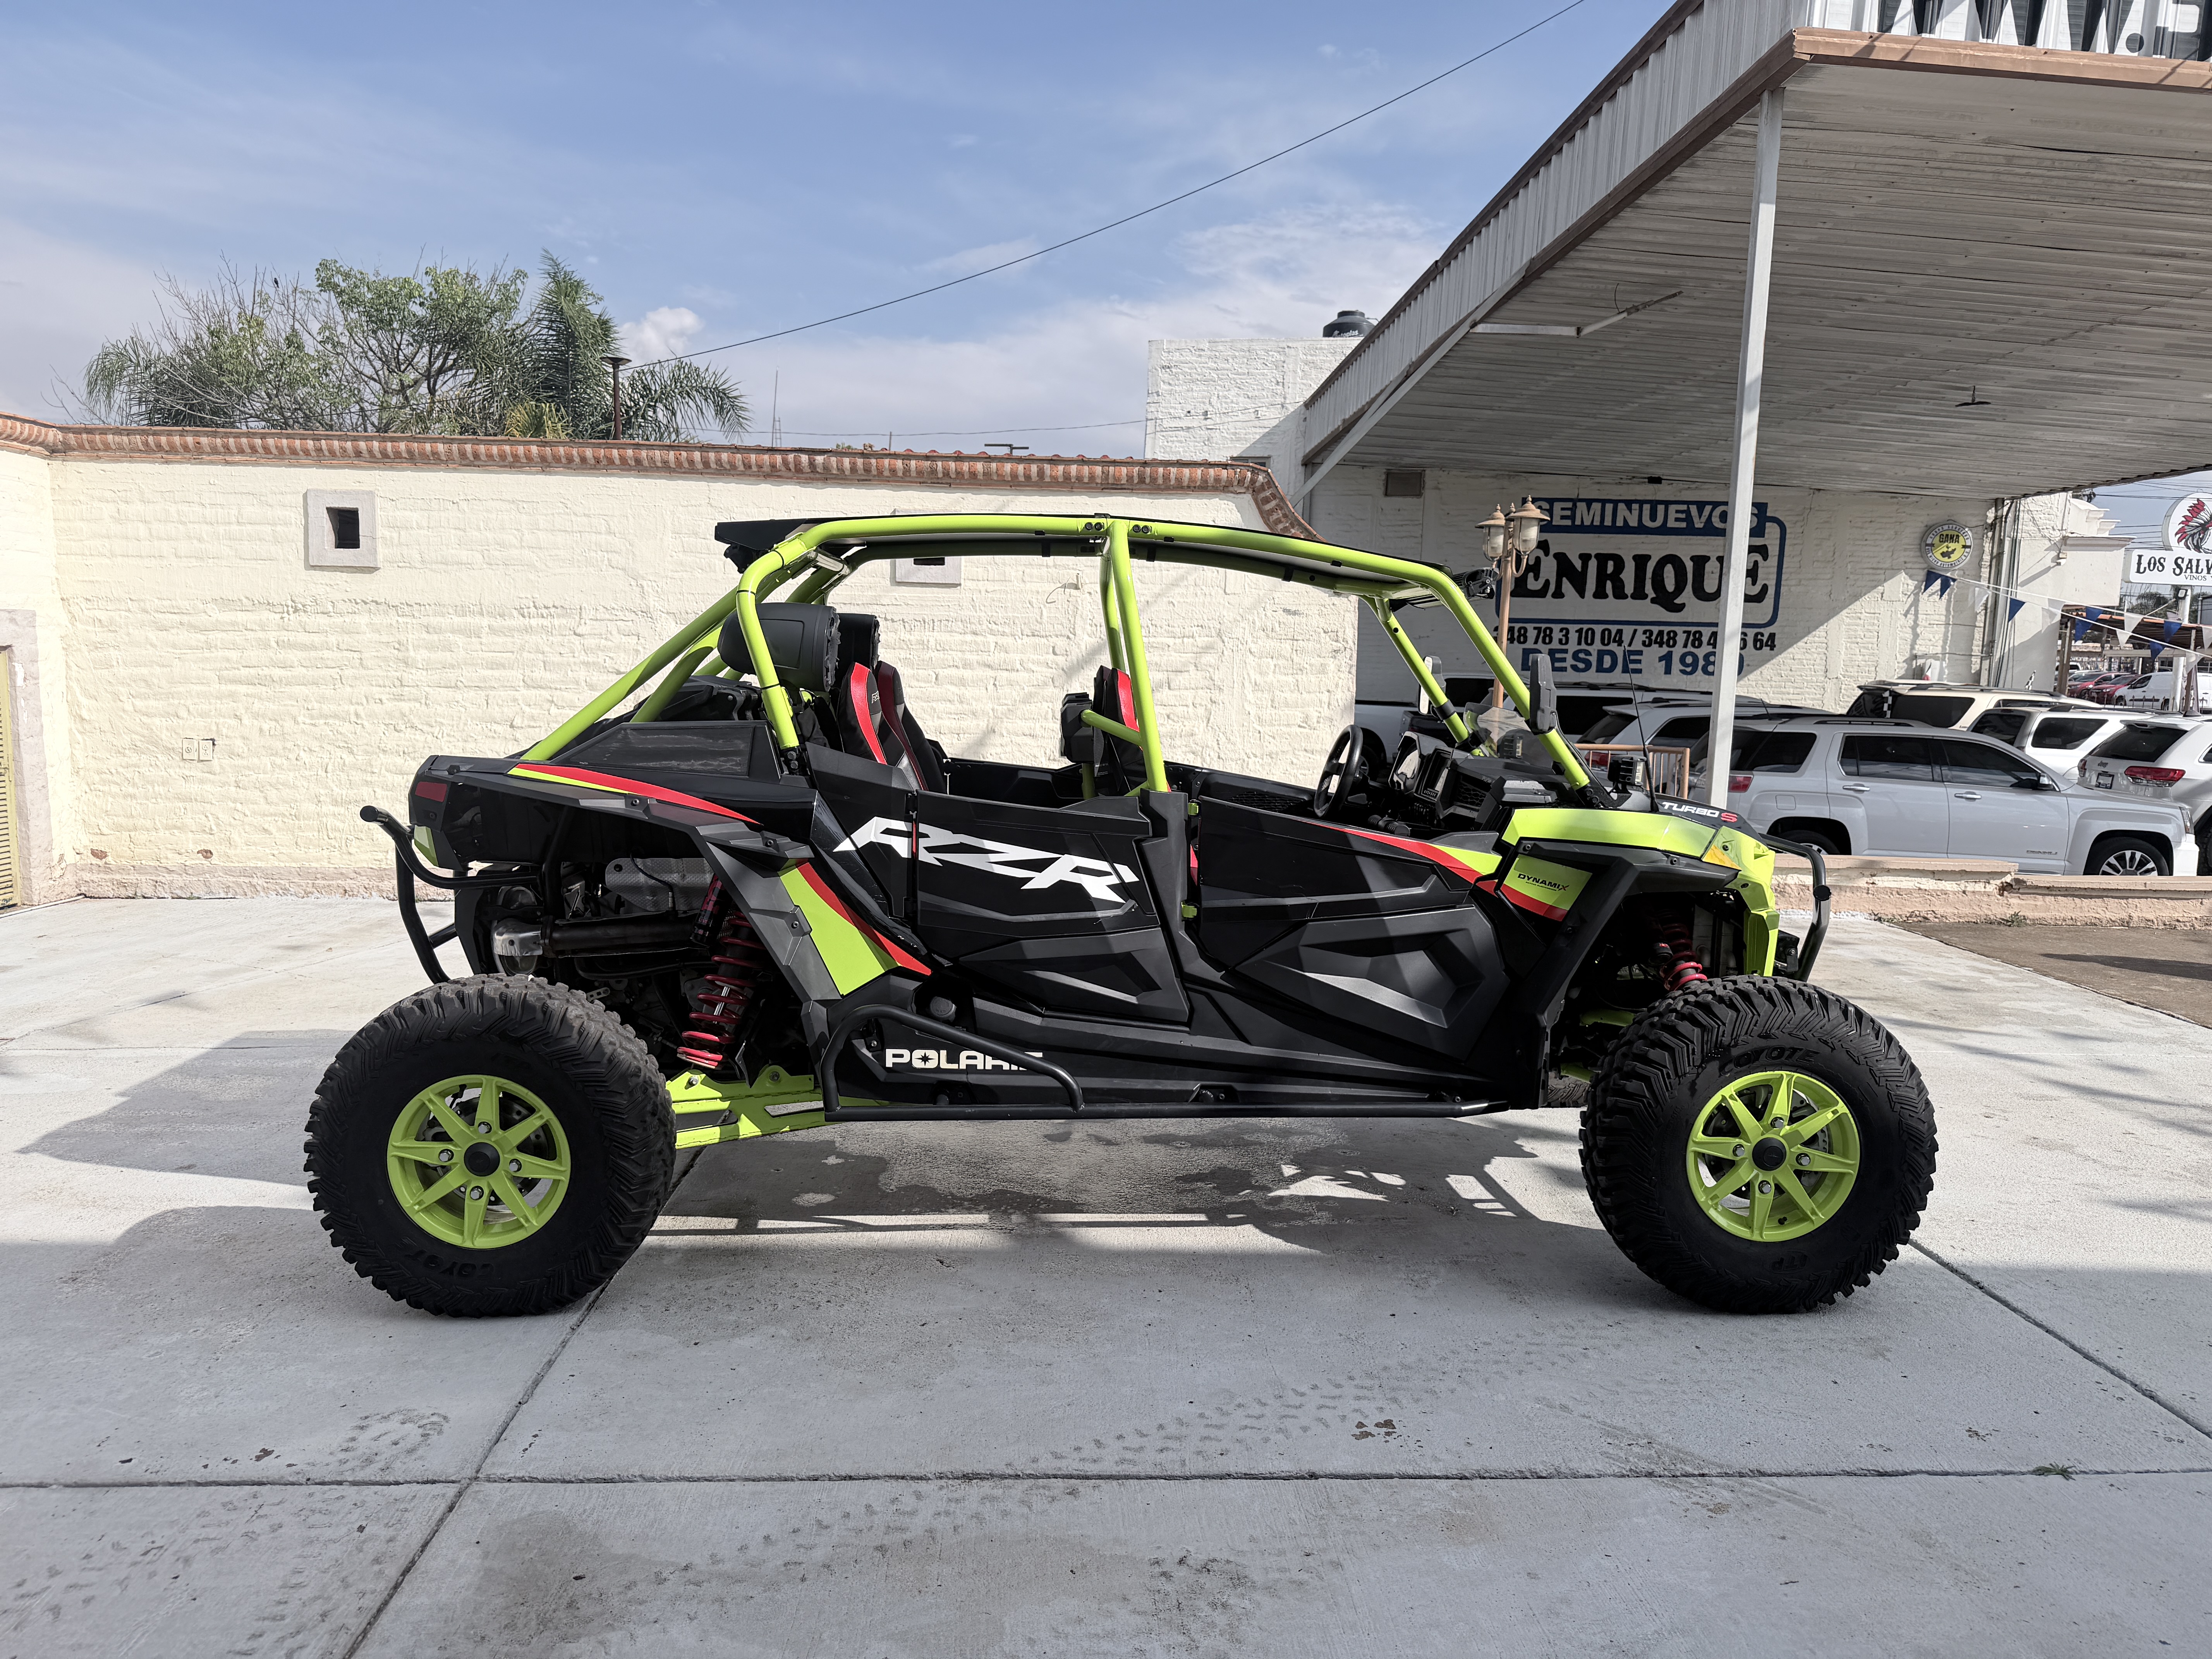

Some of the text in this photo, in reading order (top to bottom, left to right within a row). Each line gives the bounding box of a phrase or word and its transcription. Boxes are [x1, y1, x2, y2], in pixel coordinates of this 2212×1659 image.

[1939, 534, 1960, 543] GANA
[1510, 539, 1769, 612] ENRIQUE
[1533, 627, 1553, 645] 78
[1558, 627, 1570, 645] 3
[1575, 627, 1595, 646] 10
[1600, 628, 1623, 647] 04
[1642, 629, 1678, 648] 348
[1682, 630, 1703, 649] 78
[1707, 631, 1718, 649] 4
[1753, 632, 1776, 651] 64
[1521, 648, 1643, 674] DESDE
[1662, 802, 1738, 823] TURBO S
[833, 816, 1140, 903] RZR
[1517, 873, 1570, 891] DYNAMIX
[886, 1048, 1043, 1070] POLAR
